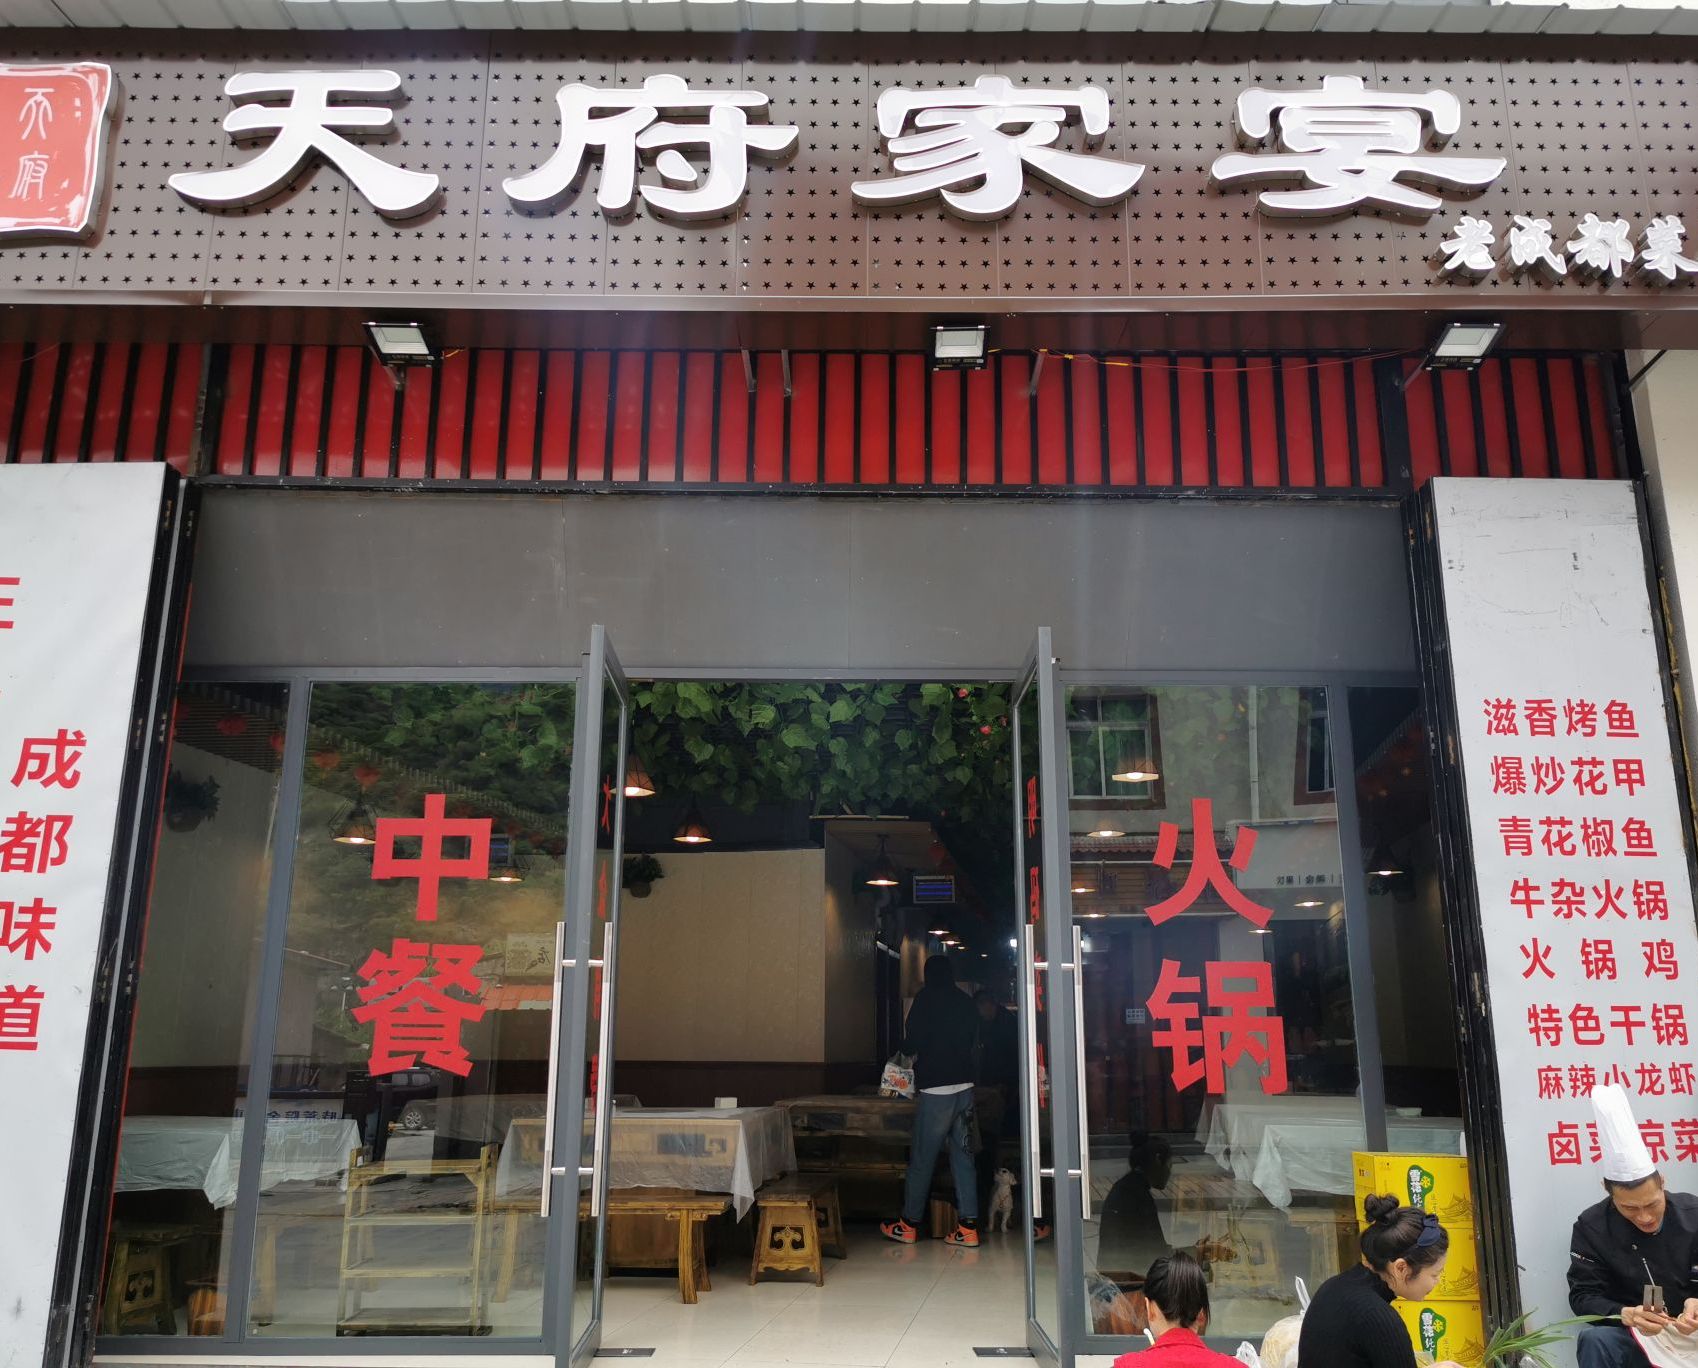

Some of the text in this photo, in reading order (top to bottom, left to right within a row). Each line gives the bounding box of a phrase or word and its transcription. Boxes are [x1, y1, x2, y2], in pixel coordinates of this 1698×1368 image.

[168, 69, 1508, 216] 天府家宴
[1439, 212, 1698, 280] 老成都菜
[1483, 698, 1640, 738] 滋香烤鱼
[1490, 756, 1646, 796] 爆炒花甲
[1499, 815, 1658, 857] 青花椒鱼
[0, 728, 87, 1051] 成都味道
[1510, 878, 1669, 921] 牛杂火锅
[351, 793, 493, 1077] 中餐
[1144, 797, 1288, 1095] 火锅
[1528, 1003, 1689, 1047] 特色干锅
[1537, 1061, 1696, 1099] 麻辣小龙虾
